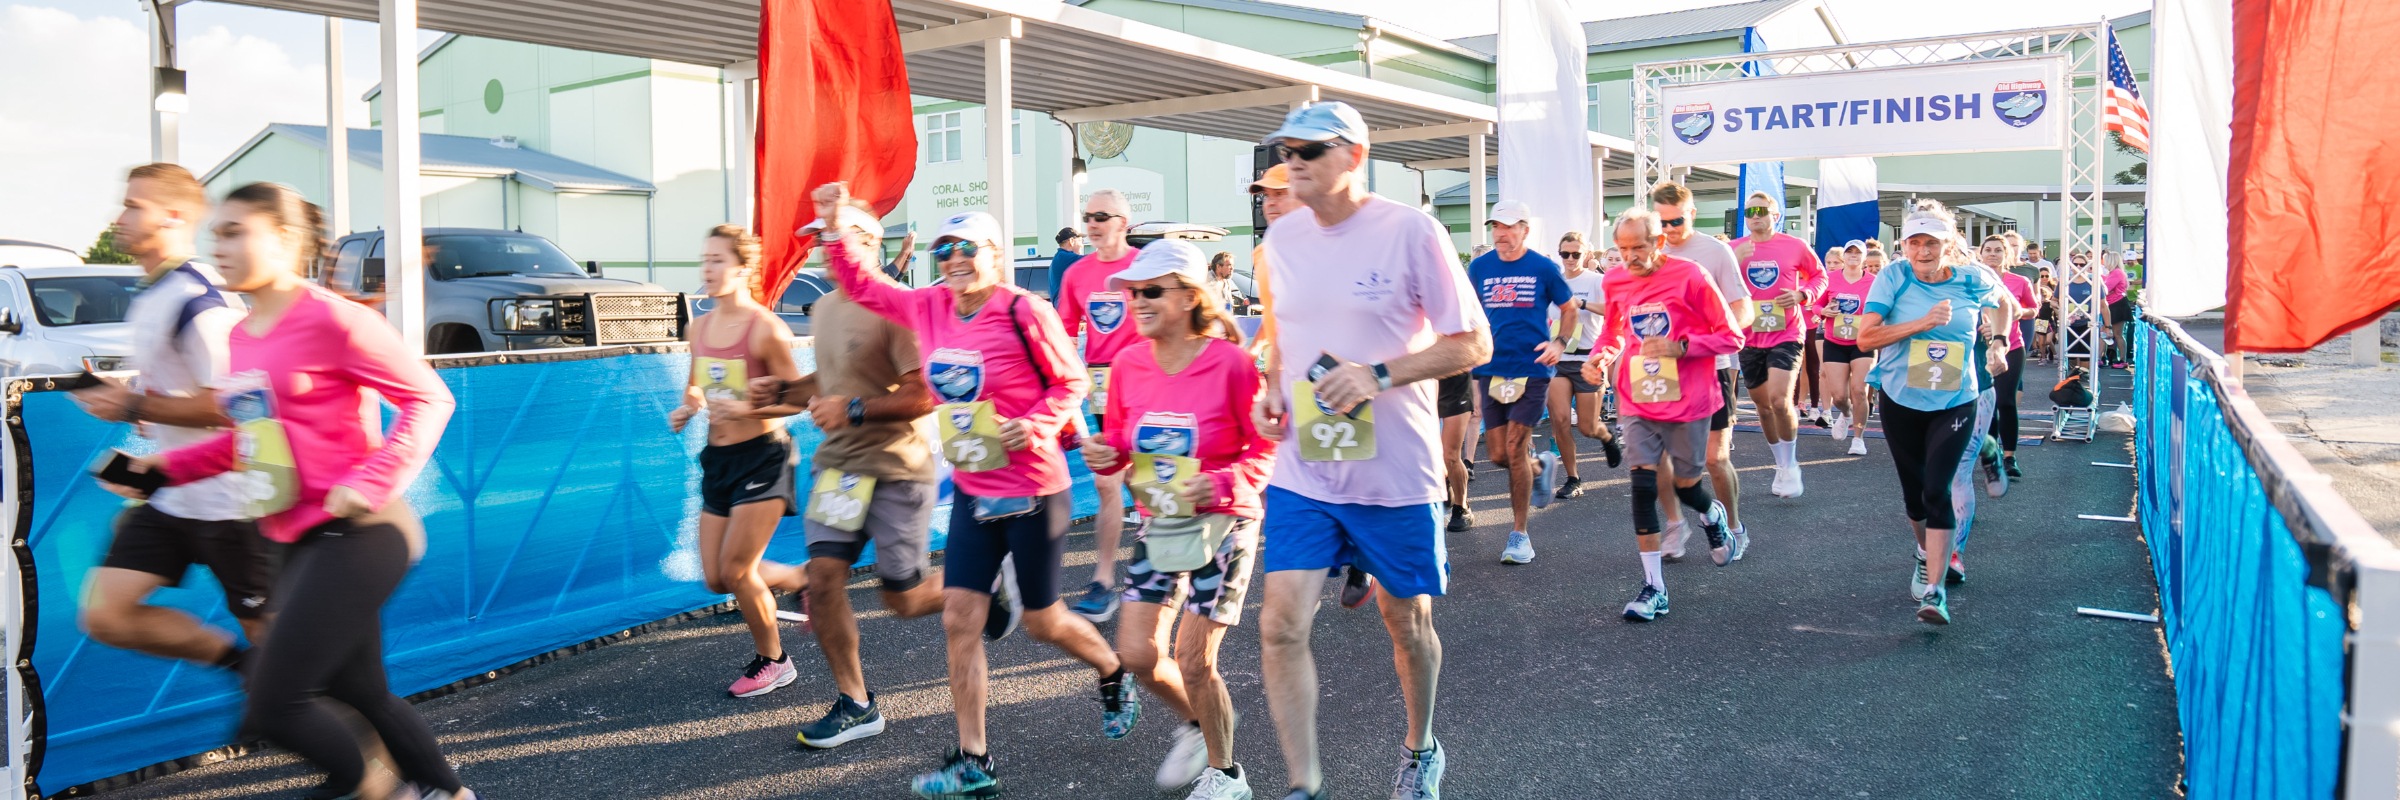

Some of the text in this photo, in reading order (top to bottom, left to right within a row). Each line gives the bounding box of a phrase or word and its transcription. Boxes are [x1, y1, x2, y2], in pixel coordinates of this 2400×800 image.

[1997, 82, 2042, 91] Old Highway
[1723, 92, 1981, 133] START/FINISH
[932, 183, 964, 195] CORAL
[936, 197, 959, 208] HIGH
[1491, 284, 1518, 303] 35
[1760, 315, 1777, 327] 78
[1840, 327, 1853, 336] 31
[1927, 366, 1943, 383] 2
[1499, 384, 1516, 397] 15
[1641, 379, 1668, 396] 35
[1311, 421, 1359, 448] 92
[951, 437, 989, 462] 75
[1145, 487, 1179, 515] 76
